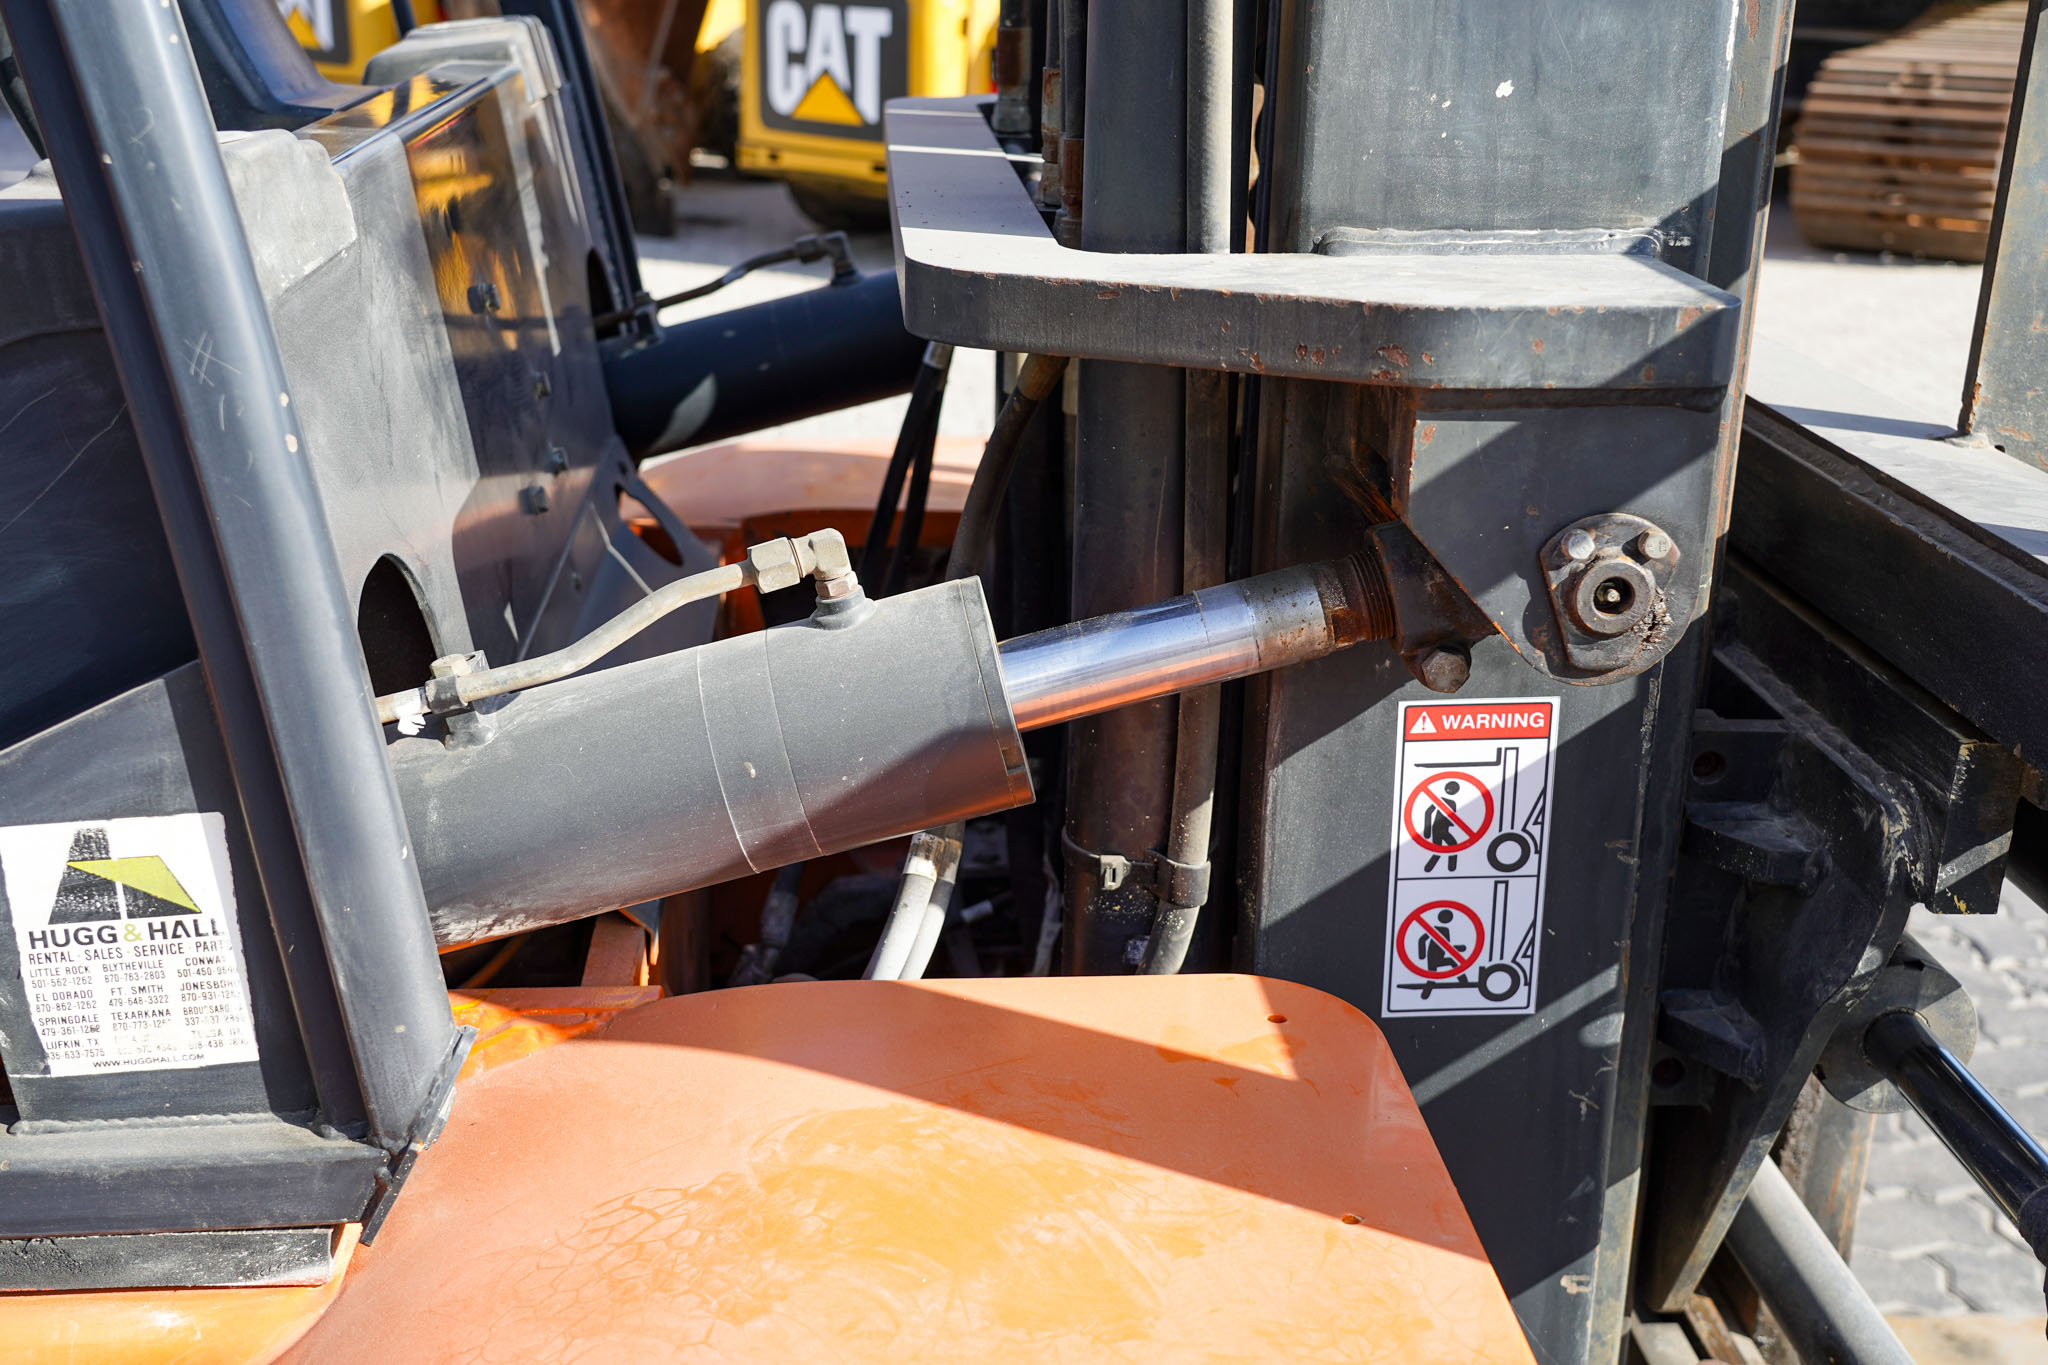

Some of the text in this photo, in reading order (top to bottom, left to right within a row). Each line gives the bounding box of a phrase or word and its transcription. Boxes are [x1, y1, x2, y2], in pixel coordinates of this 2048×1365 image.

[766, 0, 893, 125] CAT
[1441, 712, 1545, 730] WARNING
[29, 918, 225, 949] HUGG & HALL
[28, 940, 233, 965] RENTAL SALES SERVICE PAR
[102, 959, 164, 973] BLYTHEVILLE
[185, 955, 227, 967] CONWA
[29, 965, 91, 978] LITTLE ROCK
[177, 966, 239, 978] 501-450-95
[32, 976, 93, 989] 501-562-1262
[180, 979, 240, 991] JONESBOR
[35, 989, 93, 1002] EL DORADO
[131, 984, 164, 995] SMITH
[181, 990, 241, 1002] 870-931-12
[36, 1000, 97, 1013] 870-862-1262
[109, 994, 169, 1007] 479-648-3322
[38, 1013, 99, 1026] SPRINGDALE
[111, 1008, 172, 1021] TEXARKANA
[41, 1024, 101, 1036] 479-361-1262
[87, 1038, 99, 1047] TX
